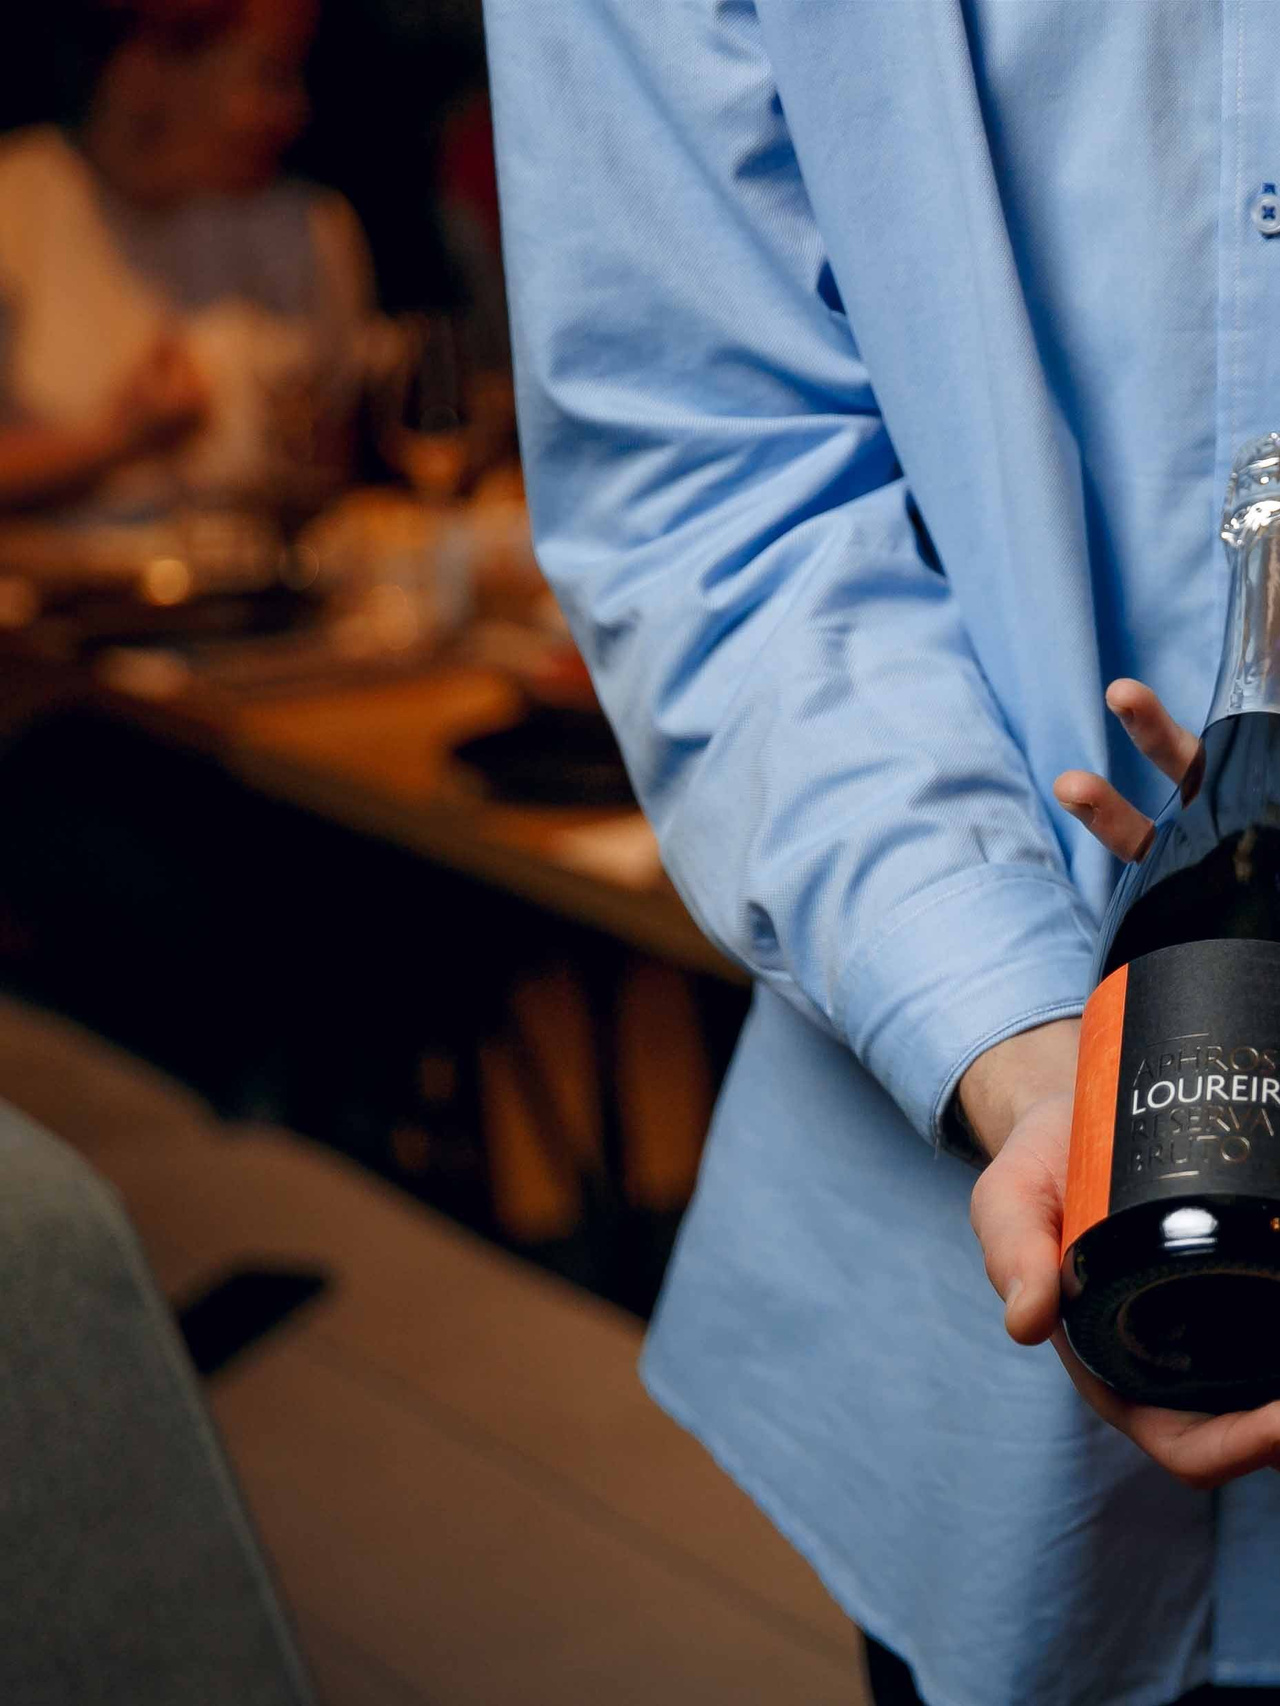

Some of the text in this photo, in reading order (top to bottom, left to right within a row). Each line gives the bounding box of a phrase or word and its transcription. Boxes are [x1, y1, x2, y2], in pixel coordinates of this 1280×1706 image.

[1132, 1046, 1277, 1087] APHROS
[1131, 1105, 1275, 1141] RESERVA
[1129, 1134, 1251, 1173] BRUTO
